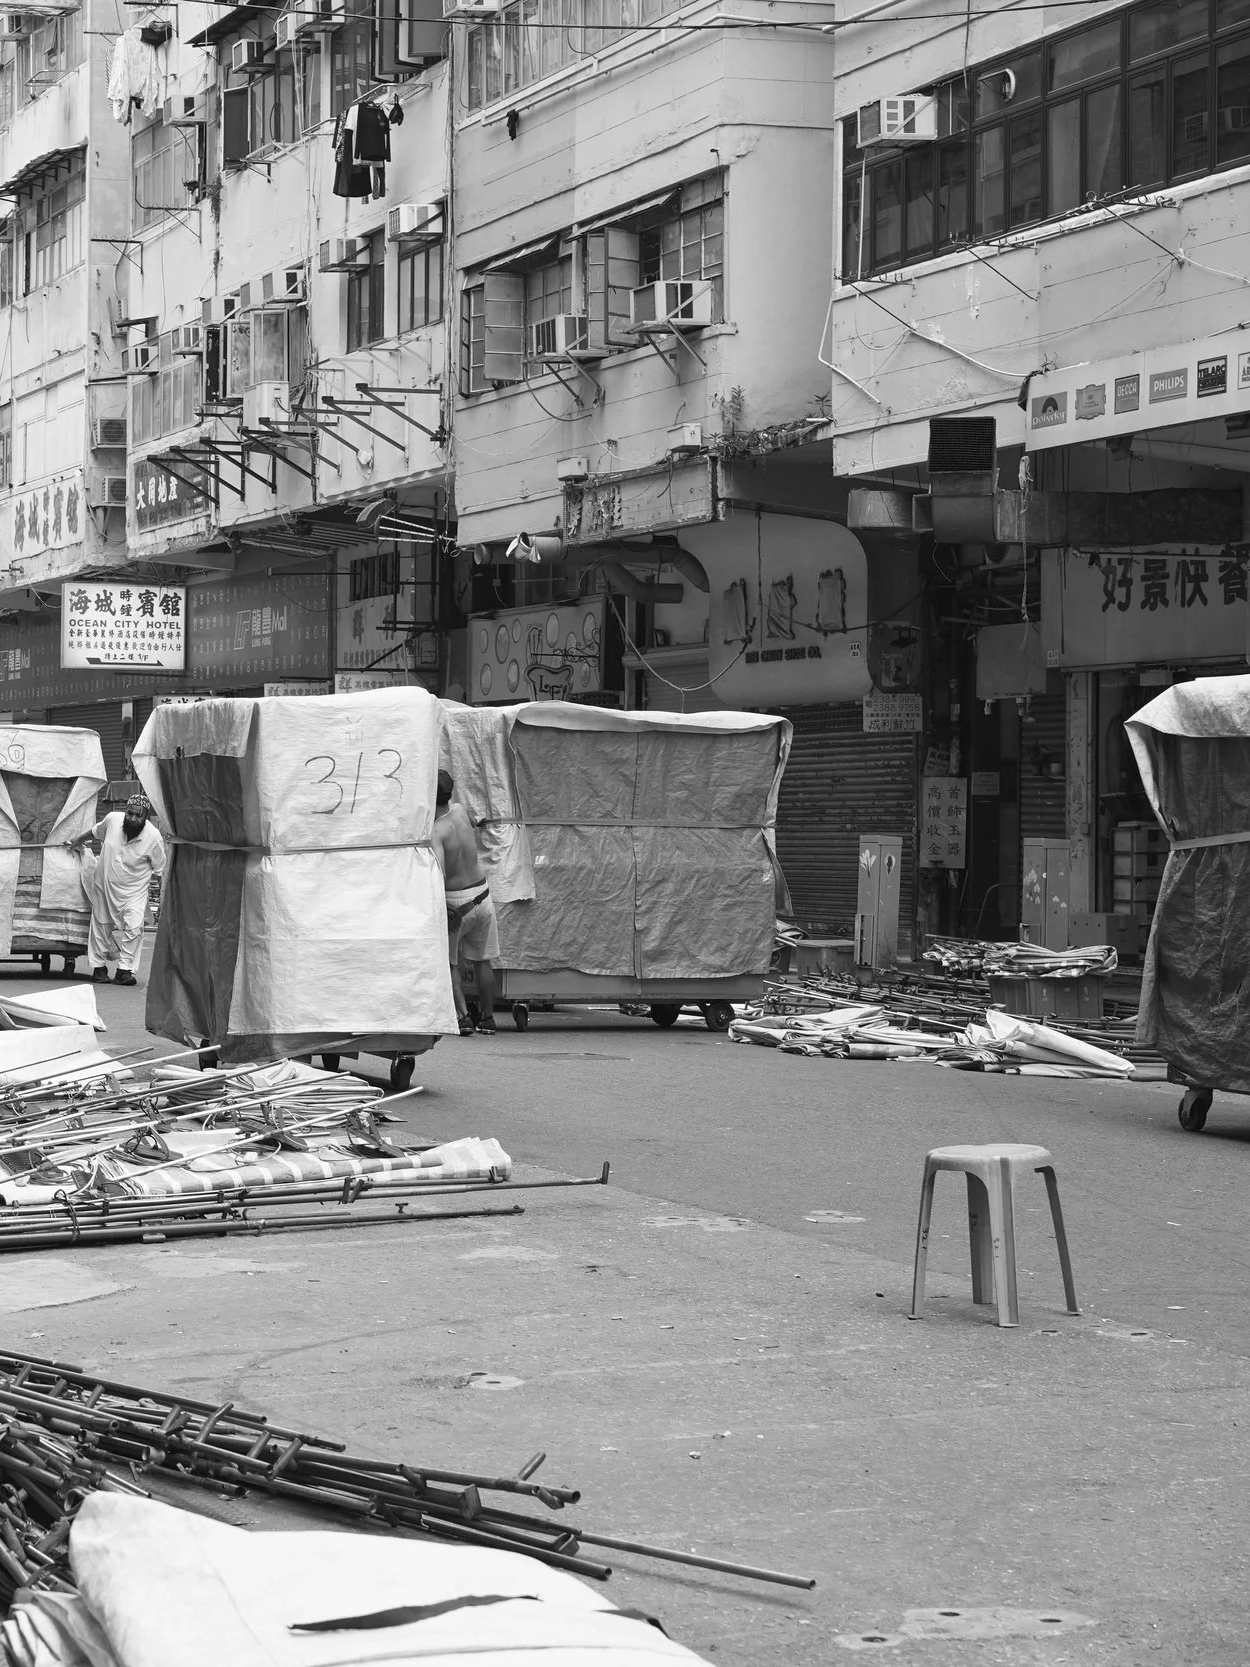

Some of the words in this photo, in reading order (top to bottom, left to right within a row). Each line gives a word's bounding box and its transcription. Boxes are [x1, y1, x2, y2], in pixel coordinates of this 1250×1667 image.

[1117, 382, 1137, 397] DECCA
[1154, 375, 1184, 392] PHILIPS
[69, 619, 107, 628] OCEAN
[114, 620, 140, 629] CITY
[146, 621, 181, 630] HOTEL
[305, 748, 403, 815] 313
